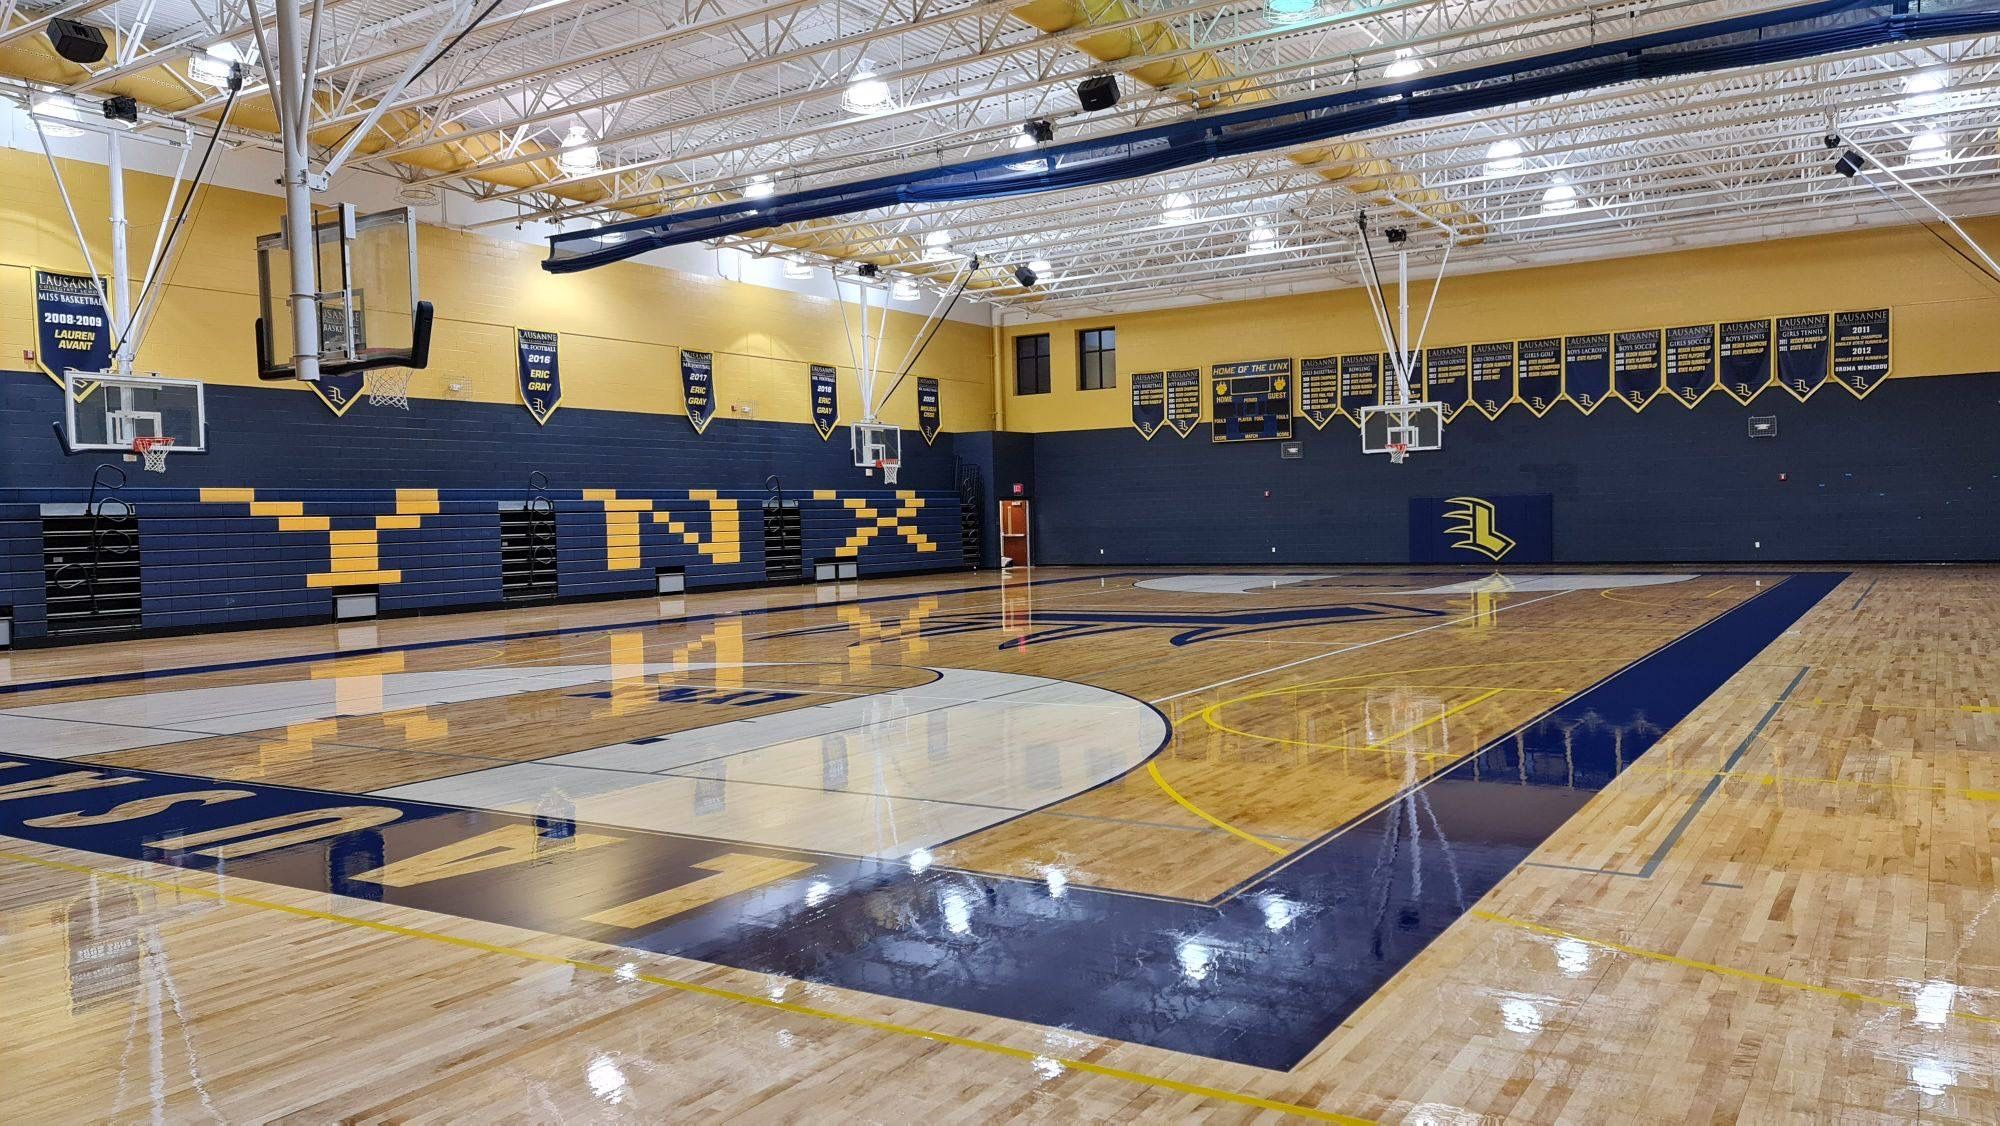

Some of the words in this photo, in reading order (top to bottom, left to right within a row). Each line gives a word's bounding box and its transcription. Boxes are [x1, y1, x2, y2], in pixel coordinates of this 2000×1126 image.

[39, 274, 105, 291] LAUSANNE
[38, 292, 58, 302] MISS
[61, 295, 104, 306] BASKETBAL
[44, 312, 102, 327] 2008-2009
[1779, 316, 1827, 327] LAUSANNE
[1836, 311, 1888, 322] LAUSANNE
[1667, 326, 1713, 337] LAUSANNE
[1721, 321, 1769, 332] LAUSANNE
[1852, 326, 1870, 334] 2011
[54, 329, 96, 340] LAUREN
[519, 331, 557, 341] LAUSANNE
[1616, 331, 1660, 342] LAUSANNE
[1742, 333, 1765, 341] TENNIS
[1782, 330, 1799, 338] GIRLS
[1800, 328, 1823, 336] TENNIS
[58, 340, 93, 350] AVANT
[1520, 340, 1560, 349] LAUSANNE
[1566, 336, 1608, 345] LAUSANNE
[1428, 347, 1466, 358] LAUSANNE
[1473, 344, 1512, 353] LAUSANNE
[1852, 347, 1872, 355] 2012
[528, 354, 551, 364] 2016
[1302, 358, 1337, 367] LAUSANNE
[1342, 355, 1377, 364] LAUSANNE
[530, 369, 550, 379] ERIC
[1213, 366, 1237, 376] HOME
[1238, 365, 1250, 374] OF
[1252, 364, 1268, 372] THE
[1269, 362, 1288, 371] LYNX
[689, 373, 707, 381] 2017
[528, 382, 552, 392] GRAY
[689, 386, 706, 395] ERIC
[817, 385, 832, 393] 2018
[688, 397, 707, 405] GRAY
